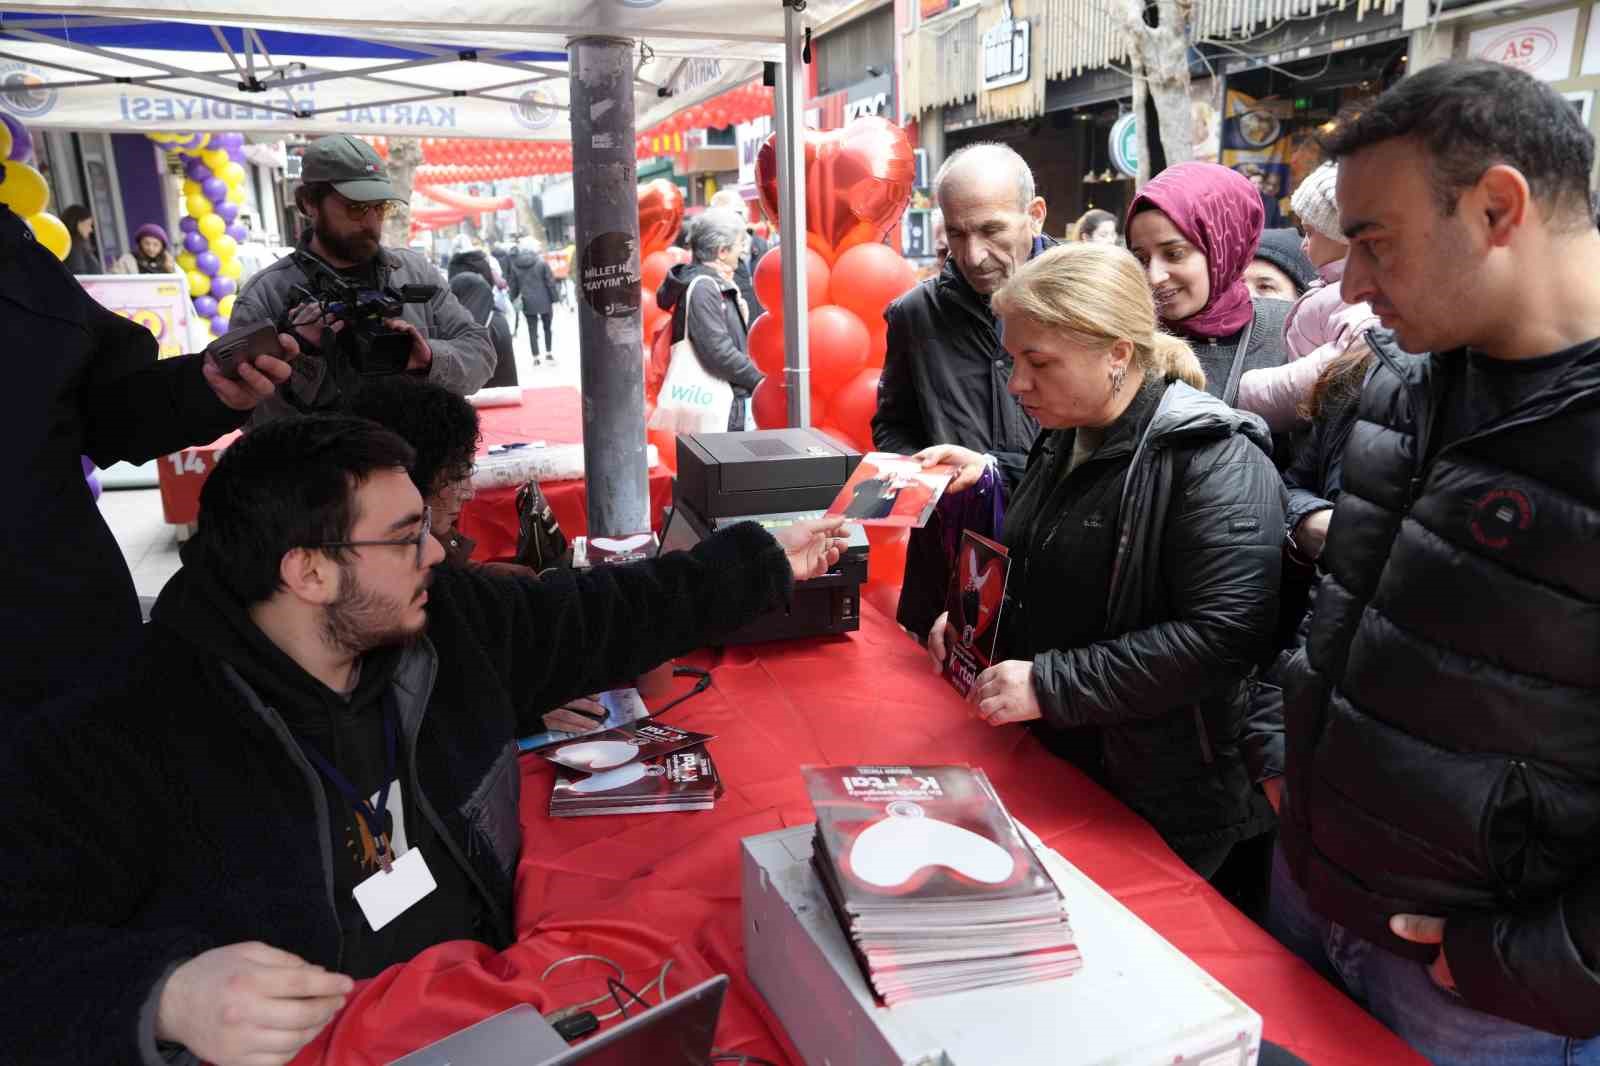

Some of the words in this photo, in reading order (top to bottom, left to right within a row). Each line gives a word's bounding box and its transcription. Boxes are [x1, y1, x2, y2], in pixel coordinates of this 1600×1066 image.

[1504, 37, 1536, 60] AS
[671, 384, 713, 405] wilo
[167, 449, 206, 475] 14
